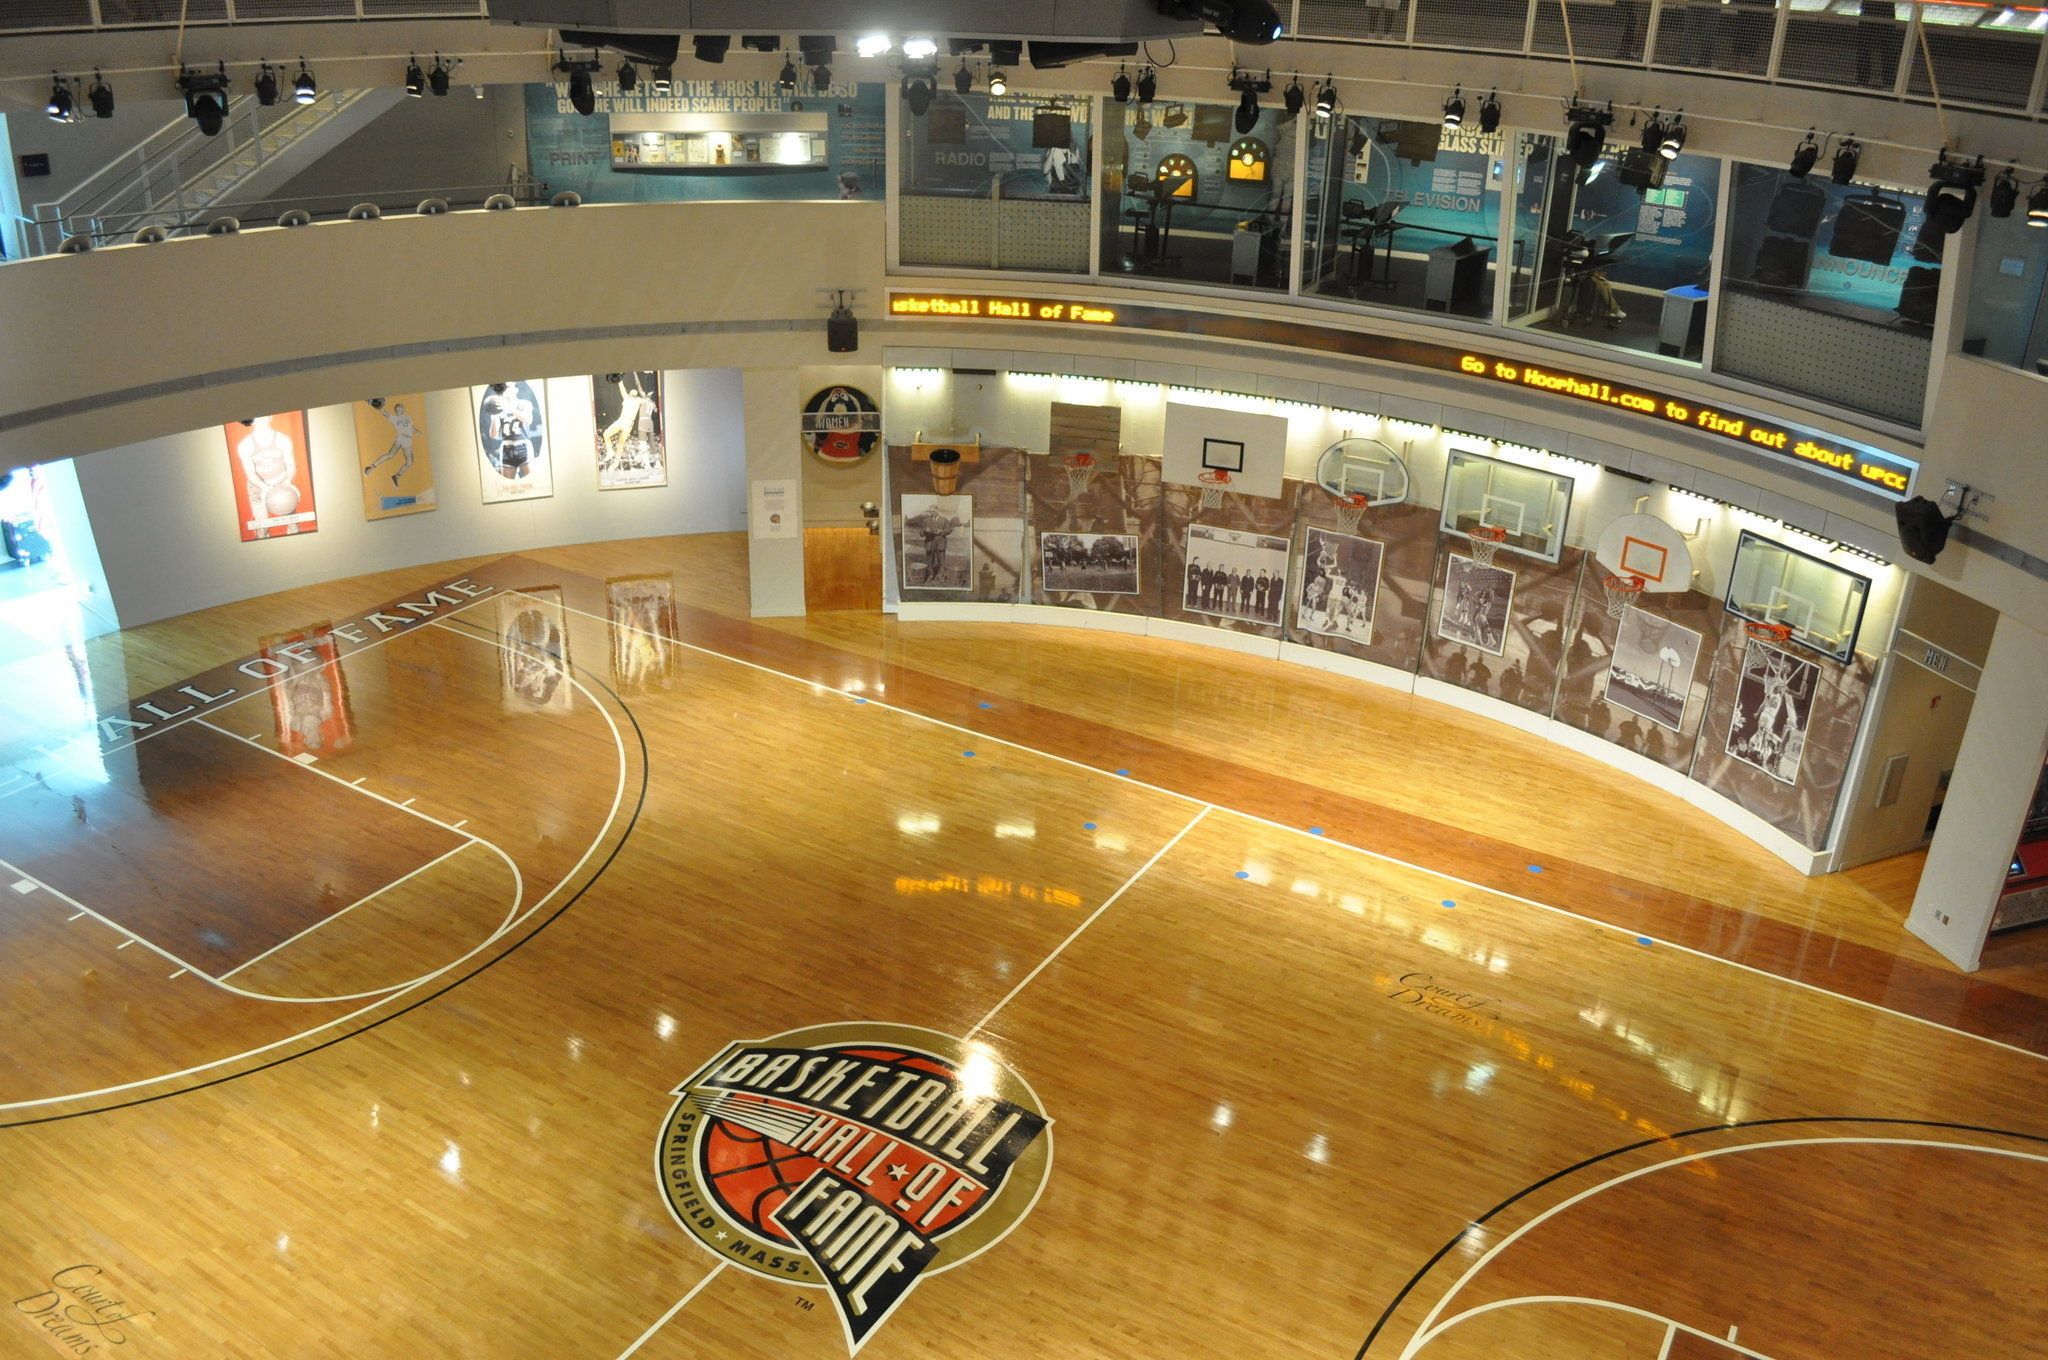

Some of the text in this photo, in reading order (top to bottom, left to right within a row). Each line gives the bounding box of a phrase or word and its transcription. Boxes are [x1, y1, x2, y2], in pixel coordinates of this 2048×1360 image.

[688, 80, 715, 97] THE
[759, 81, 777, 97] HE
[595, 98, 611, 113] HE
[613, 98, 643, 113] WILL
[646, 98, 689, 113] INDEED
[691, 97, 731, 113] SCARE
[987, 105, 1011, 120] AND
[1013, 105, 1034, 121] THE
[550, 151, 600, 167] PRINT
[935, 152, 986, 167] RADIO
[1384, 188, 1480, 213] TEEVISION
[988, 301, 1031, 317] Hall
[1039, 305, 1064, 319] of
[1070, 306, 1115, 323] Fame
[816, 416, 849, 430] WOMEN
[1461, 355, 1485, 374] Go
[1495, 362, 1517, 380] to
[1523, 368, 1656, 413] Hoophall.com
[1665, 402, 1688, 421] to
[1698, 410, 1744, 437] find
[1750, 428, 1788, 450] out
[1793, 441, 1854, 471] about
[237, 642, 318, 681] OF
[328, 577, 496, 645] FAME
[1924, 648, 1949, 672] MEN
[719, 1053, 1024, 1176] BASKETBALL
[791, 1113, 976, 1228] HALL OF
[665, 1111, 811, 1276] SPRINGFIELD MASS.
[786, 1177, 925, 1317] FAME
[52, 1264, 126, 1315] Court
[793, 1295, 816, 1313] TM
[12, 1290, 98, 1355] Dreams
